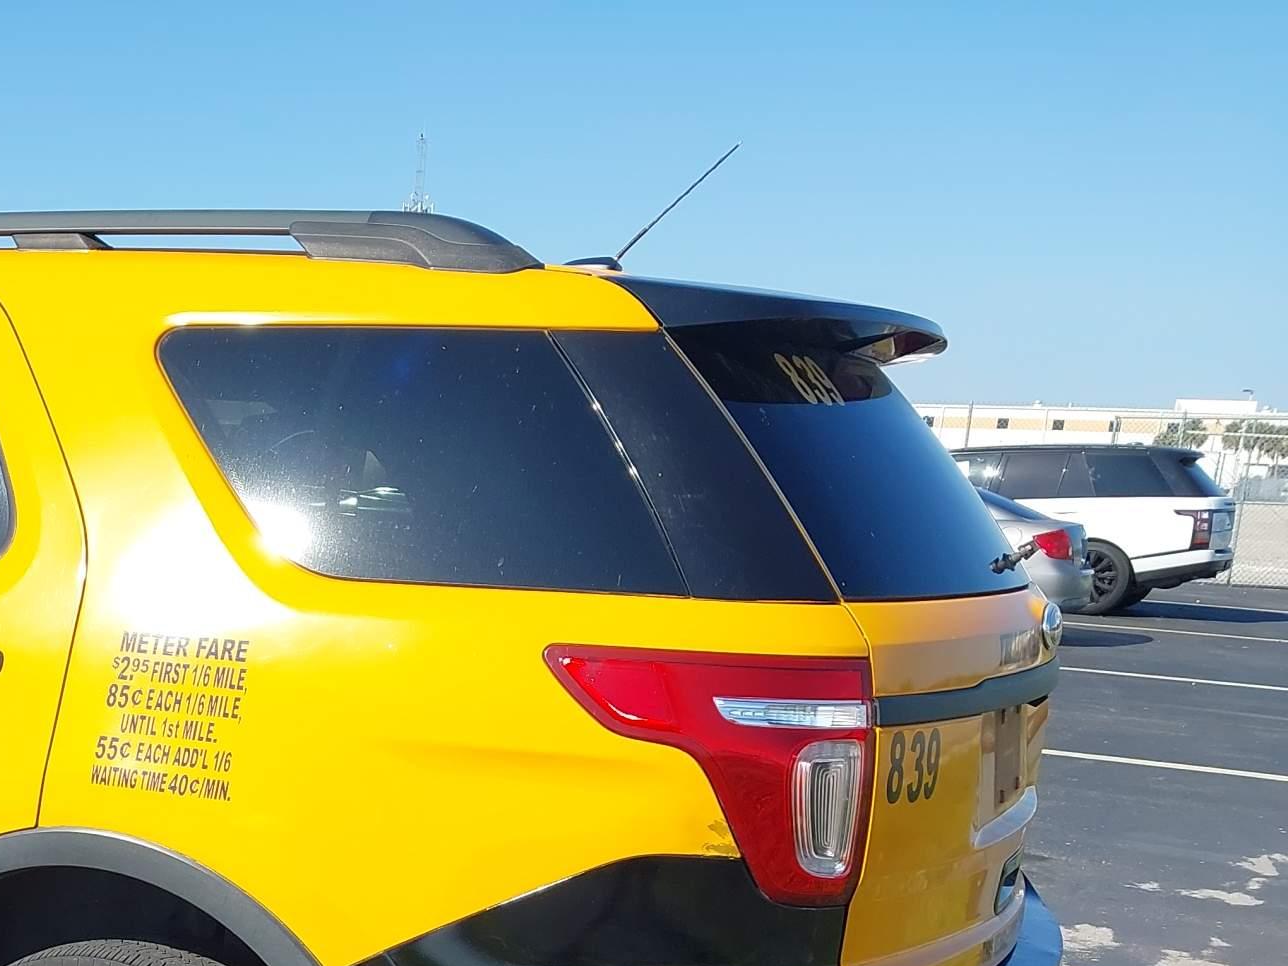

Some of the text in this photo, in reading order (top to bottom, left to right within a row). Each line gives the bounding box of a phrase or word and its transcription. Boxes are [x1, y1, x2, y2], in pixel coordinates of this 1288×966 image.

[774, 353, 845, 406] 839
[120, 631, 249, 662] METER FARE
[151, 661, 189, 684] FIRST
[192, 666, 212, 687] 1/6
[214, 667, 248, 695] MILE,
[106, 684, 242, 724] 85¢ EACH 1/6 MILE,
[120, 714, 217, 743] UNTIL 1st MILE.
[95, 736, 232, 772] 55¢ EACH ADD'L 1/6
[887, 728, 941, 805] 839
[91, 765, 231, 801] WAITING TIME 40¢/MIN.
